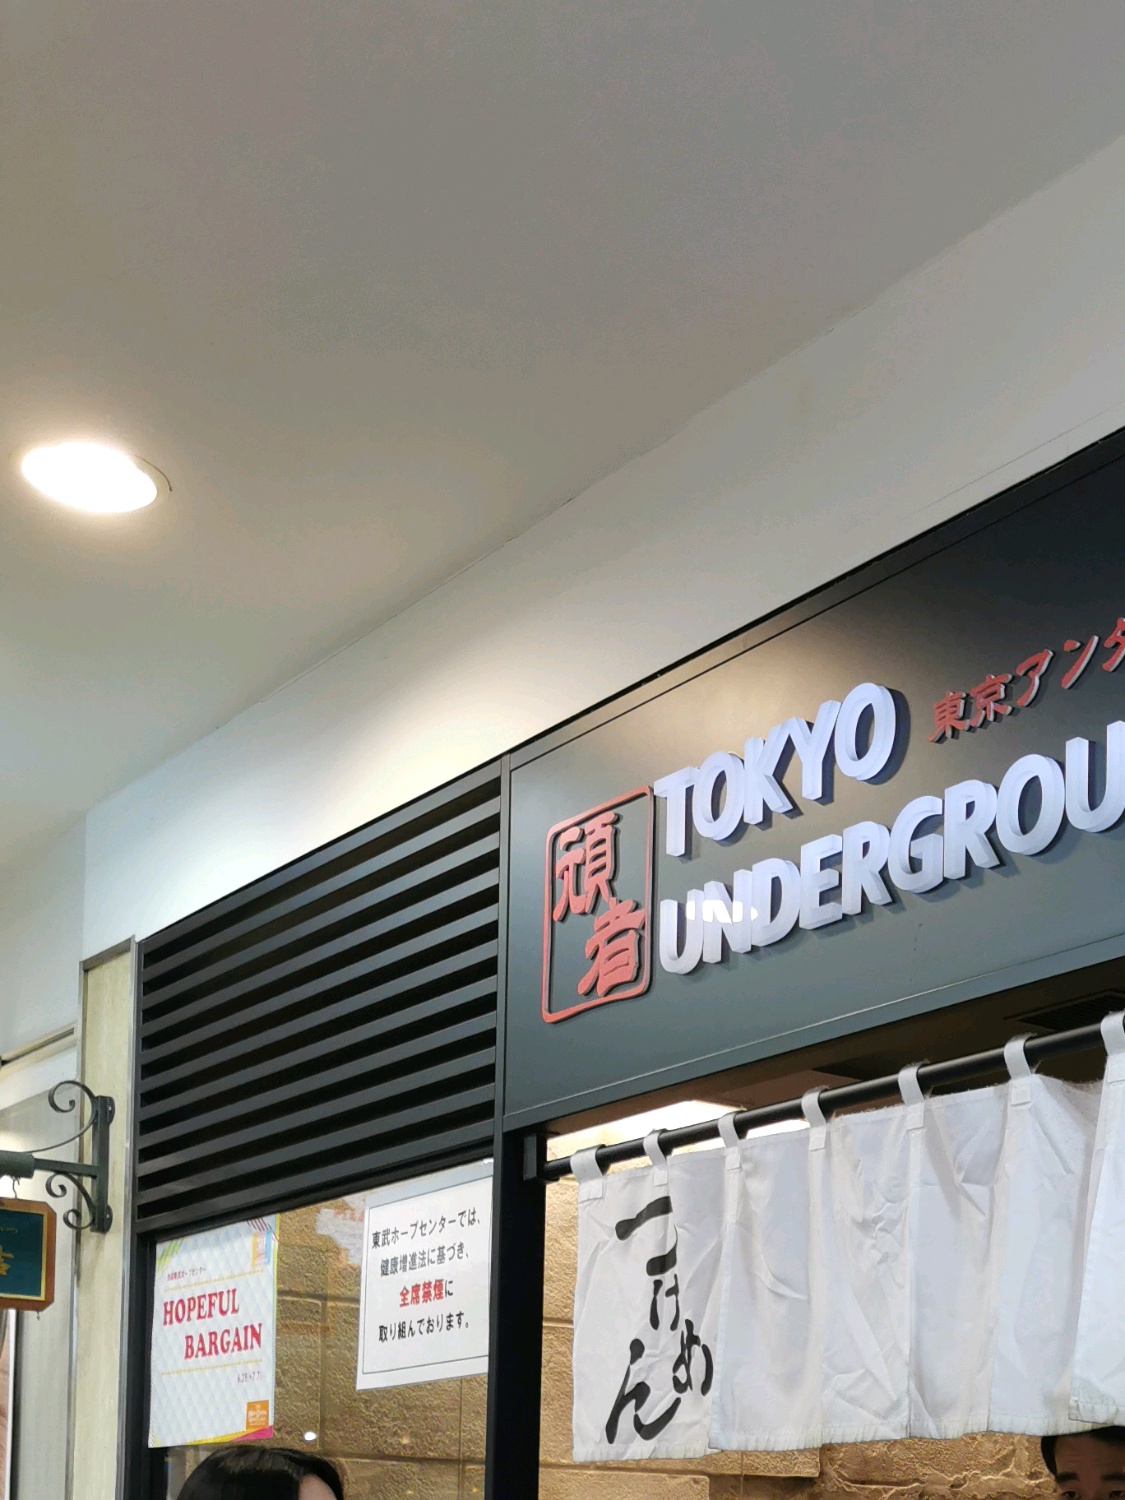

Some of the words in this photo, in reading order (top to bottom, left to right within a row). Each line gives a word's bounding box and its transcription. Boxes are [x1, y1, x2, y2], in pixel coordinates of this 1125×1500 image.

[654, 682, 896, 857] TOKYO
[552, 811, 646, 998] 頑者
[371, 1207, 481, 1249] 東武ホープセンターでは、
[380, 1241, 469, 1277] 健康増進法に基づき、
[163, 1288, 240, 1326] HOPEFUL
[399, 1279, 454, 1308] 全席禁煙に
[378, 1311, 469, 1343] 取り組んでおります。
[605, 1196, 714, 1444] つけめん
[184, 1323, 263, 1360] BARGAIN
